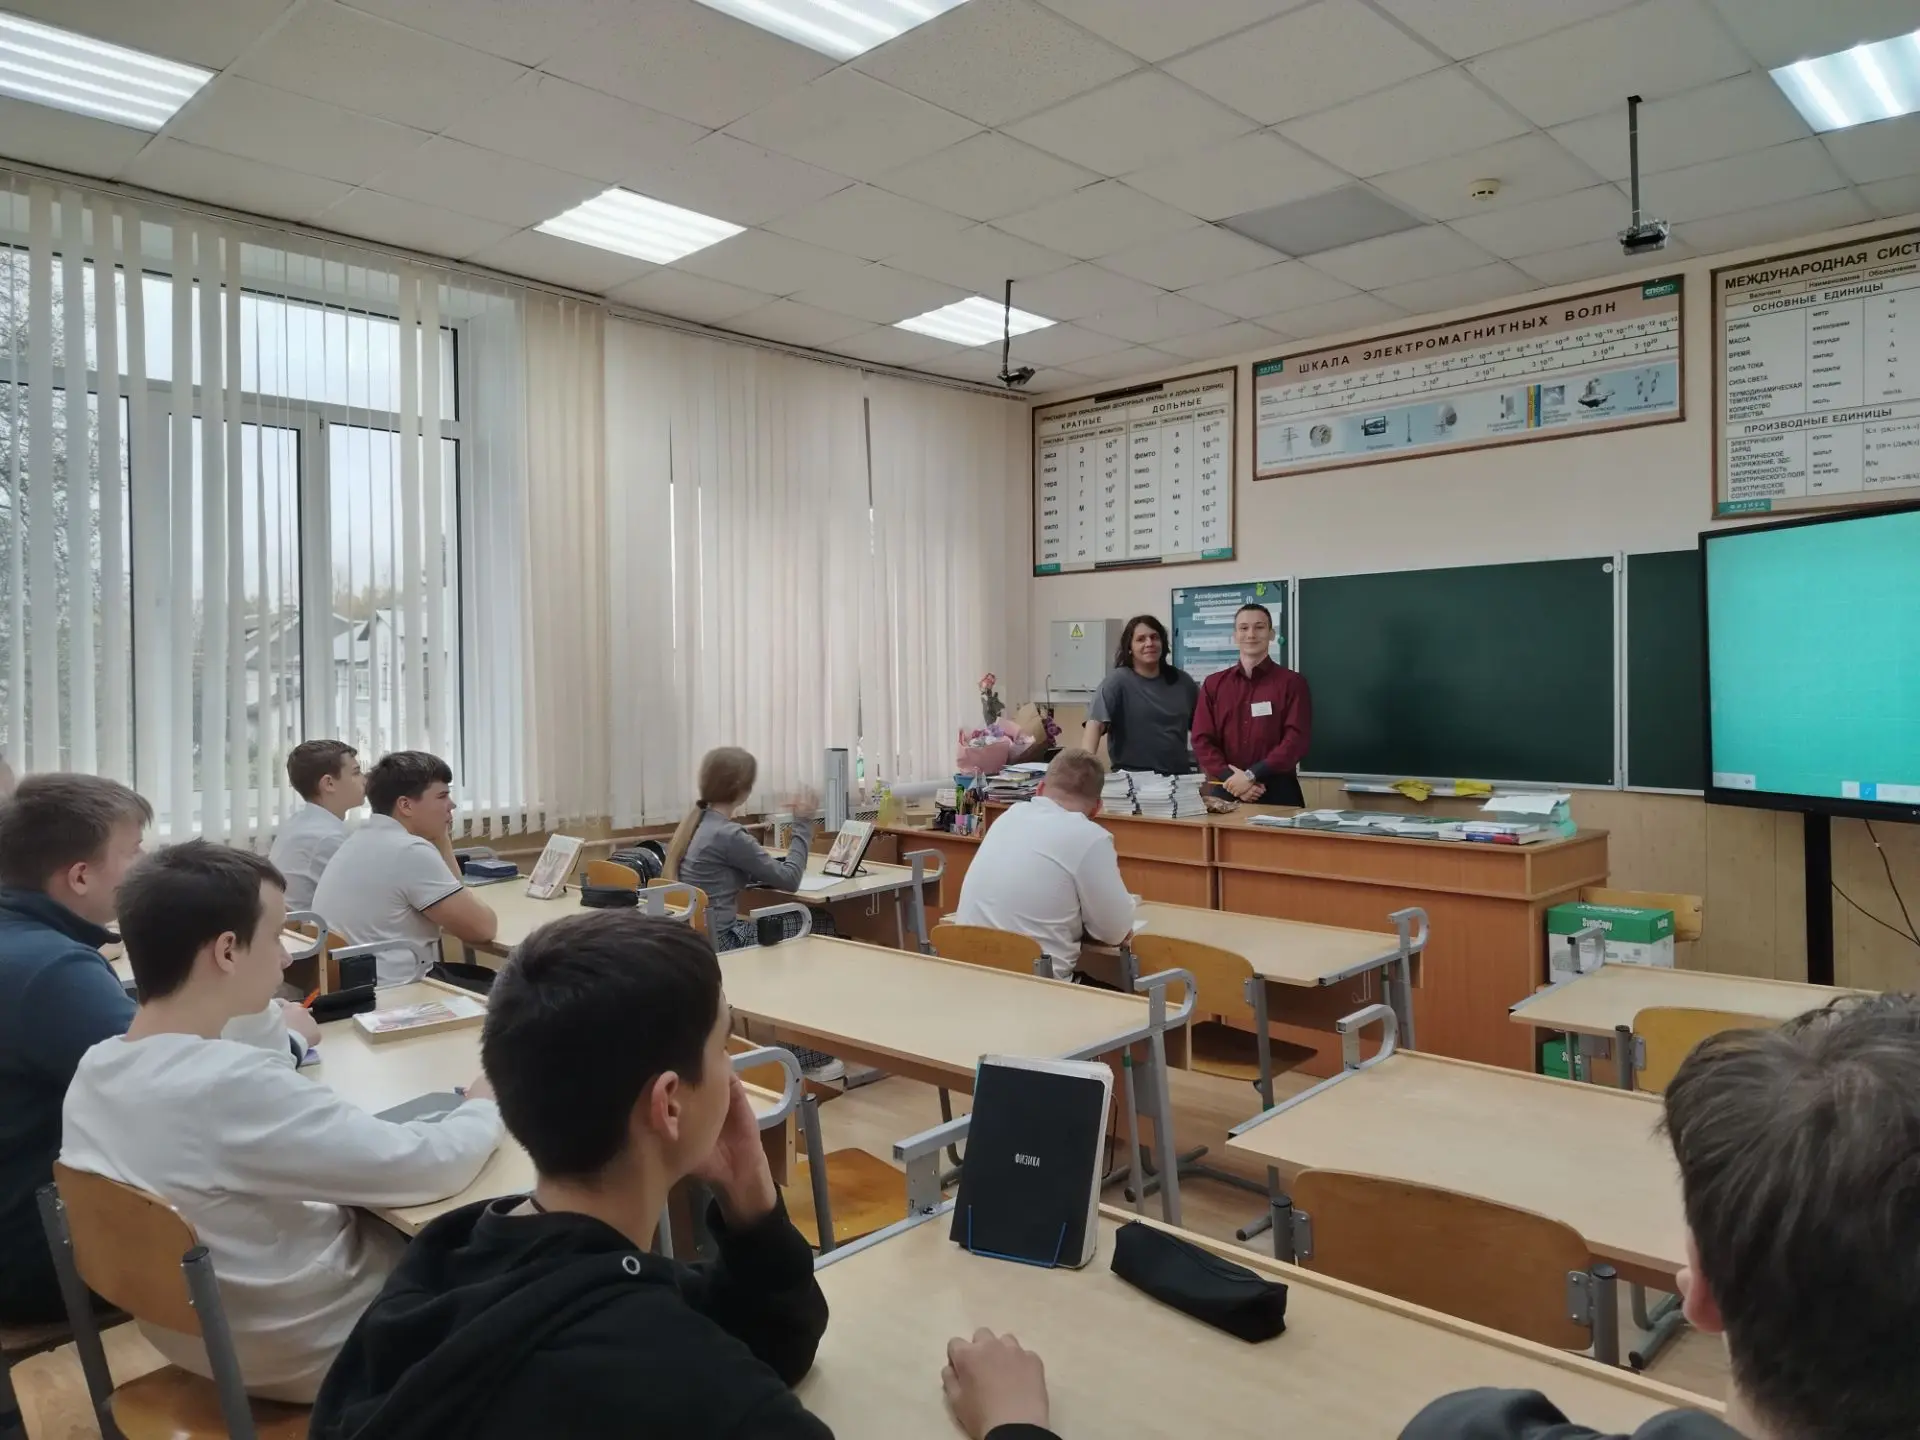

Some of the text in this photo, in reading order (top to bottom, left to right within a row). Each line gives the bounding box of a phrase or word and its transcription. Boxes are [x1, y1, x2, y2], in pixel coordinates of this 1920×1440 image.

[1725, 252, 1868, 289] МЕЖДУНАРОДНАЯ
[1809, 274, 1860, 288] Наименование
[1749, 288, 1781, 299] Величина
[1752, 282, 1884, 313] ОСНОВНЫЕ ЕДИНИЦЫ
[1812, 309, 1829, 317] метр
[1728, 321, 1750, 332] ДЛИНА
[1299, 355, 1350, 374] ШКАЛА
[1363, 315, 1548, 360] ЭЛЕКТРОМАГНИТНЫХ
[1565, 301, 1616, 321] ВОЛН
[1728, 336, 1751, 345] МАССА
[1812, 337, 1840, 346] секунда
[1728, 350, 1751, 359] ВРЕМЯ
[1728, 361, 1764, 373] СИЛА ТОКА
[1728, 374, 1768, 386] СИЛА СВЕТА
[1728, 382, 1803, 398] ТЕРМОДИНАМИЧЕСКАЯ
[1728, 393, 1773, 405] ТЕМПЕРАТУРА
[1152, 397, 1202, 414] ДОЛЬНЫЕ
[1728, 402, 1771, 413] КОЛИЧЕСТВО
[1728, 410, 1765, 420] ВЕЩЕСТВА
[1744, 407, 1892, 434] ПРОИЗВОДНЫЕ ЕДИНИЦЫ
[1061, 417, 1102, 430] КРАТНЫЕ
[1730, 435, 1784, 447] ЭЛЕКТРИЧЕСКИЙ
[1730, 446, 1751, 454] ЗАРЯД
[1730, 451, 1784, 461] ЭЛЕКТРИЧЕСКОЕ
[1730, 466, 1788, 477] НАПРЯЖЕННОСТЬ
[1730, 473, 1786, 484] ЭЛЕКТРИЧЕСКОГО
[1730, 482, 1784, 492] ЭЛЕКТРИЧЕСКОЕ
[1730, 489, 1786, 500] СОПРОТИВЛЕНИЕ
[1015, 1153, 1040, 1167] ФИЗИКА
